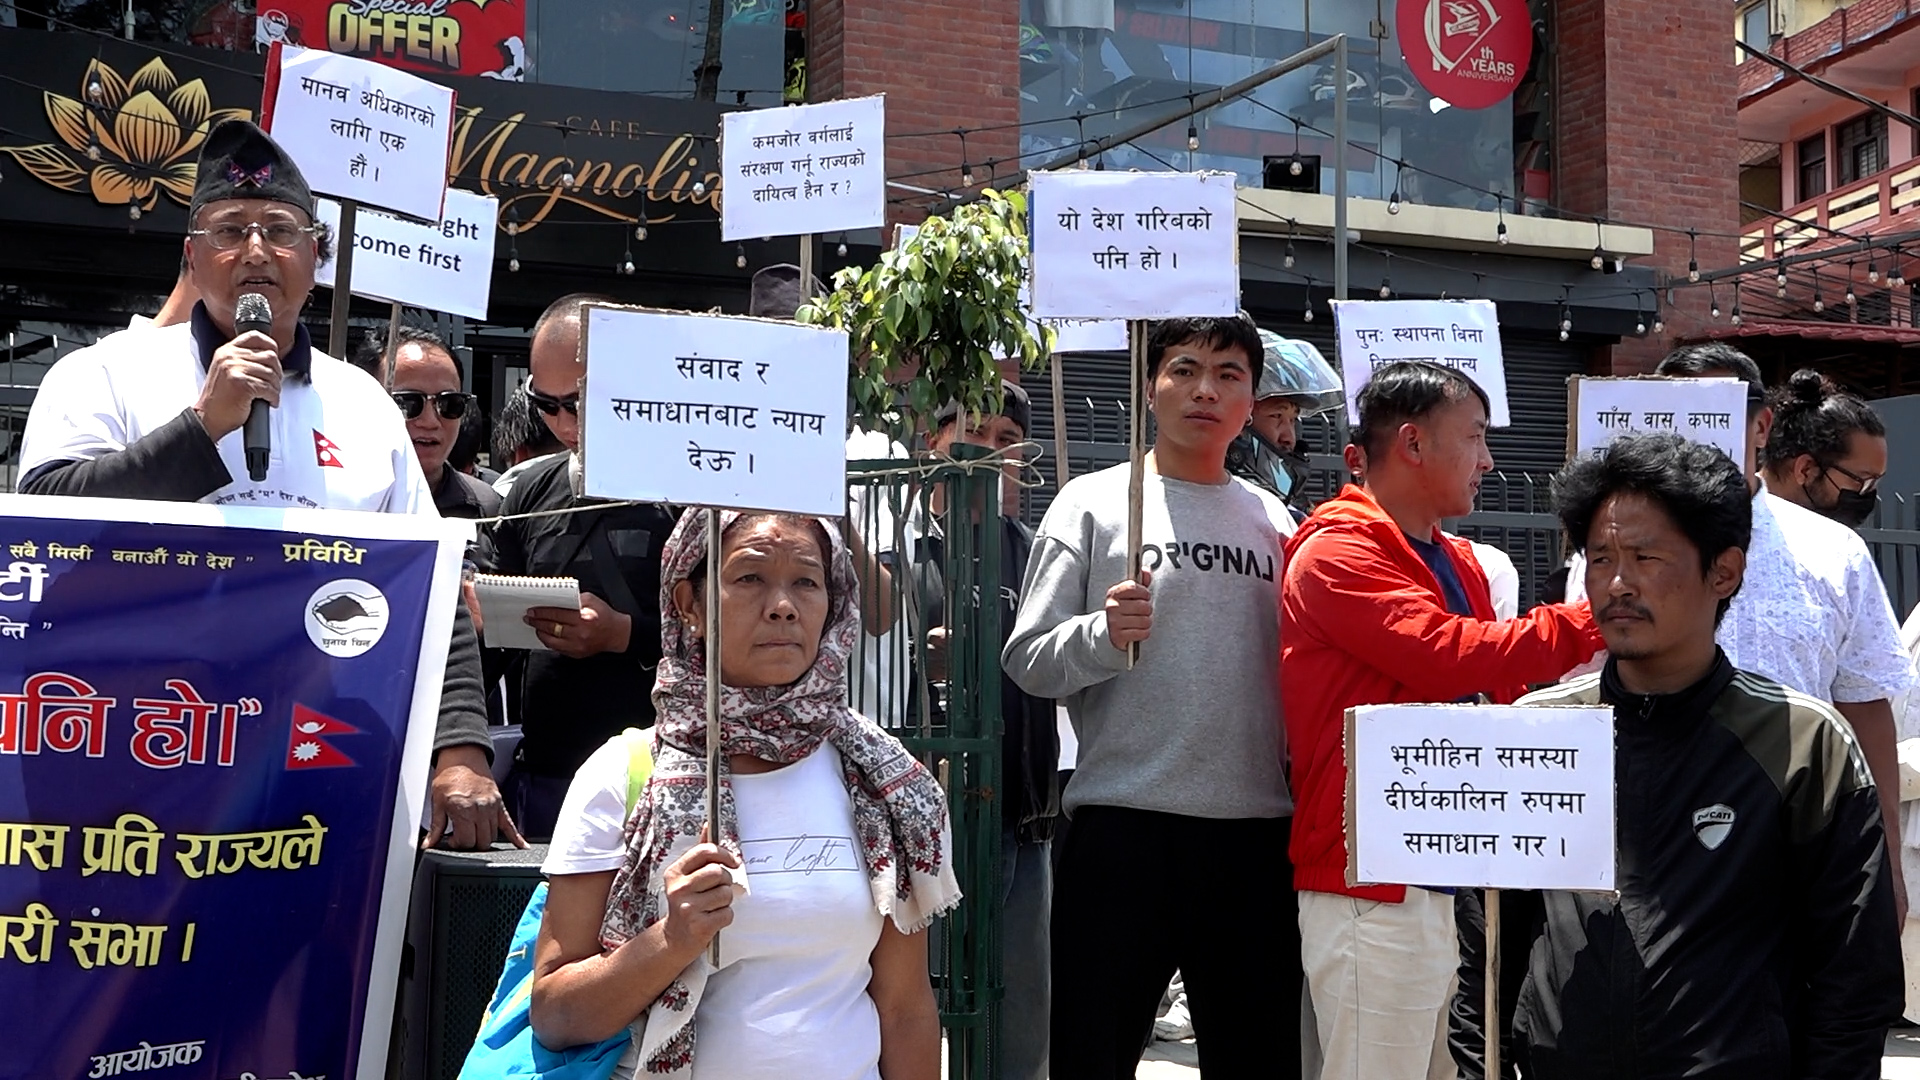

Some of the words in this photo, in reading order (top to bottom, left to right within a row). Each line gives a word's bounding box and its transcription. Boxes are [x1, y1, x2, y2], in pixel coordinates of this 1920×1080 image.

[328, 3, 461, 70] OFFER
[1470, 57, 1515, 76] YEARS
[1480, 46, 1494, 60] th
[1457, 69, 1514, 83] ANNIVERSARY
[301, 77, 350, 103] मानव
[360, 89, 436, 128] अधिकारको
[330, 117, 372, 143] लागि
[380, 131, 407, 152] एक
[566, 116, 641, 141] CAFE
[753, 130, 801, 149] कमजोर
[808, 122, 853, 144] वर्गलाई
[740, 161, 784, 178] संरक्षण
[819, 148, 866, 170] राज्यको
[753, 184, 797, 203] दायित्व
[804, 179, 823, 200] हैन
[830, 182, 839, 195] र
[437, 217, 479, 241] ght
[1057, 207, 1081, 231] यो
[1091, 207, 1124, 231] देश
[1135, 206, 1212, 231] गरिबको
[418, 243, 462, 272] first
[1093, 245, 1129, 269] पनि
[1140, 246, 1161, 271] हो
[1392, 327, 1445, 342] स्थापना
[675, 352, 743, 381] संवाद
[755, 362, 770, 385] र
[611, 398, 758, 428] समाधानबाट
[771, 409, 826, 435] न्याय
[1688, 413, 1731, 429] कपास
[687, 440, 736, 471] देऊ
[10, 540, 39, 559] सबै
[47, 543, 94, 561] मिली
[176, 551, 199, 566] यो
[206, 552, 235, 569] देश
[283, 539, 367, 565] प्रविधि
[1391, 738, 1482, 775] भूमीहिन
[1495, 747, 1579, 769] समस्या
[1384, 781, 1508, 811] दीर्घकालिन
[1521, 791, 1586, 814] रुपमा
[82, 814, 165, 877] प्रति
[176, 814, 328, 878] राज्यले
[745, 855, 772, 865] our
[783, 833, 846, 876] light
[1403, 833, 1500, 855] समाधान
[1512, 835, 1547, 857] गर
[89, 1040, 206, 1079] आयोजक
